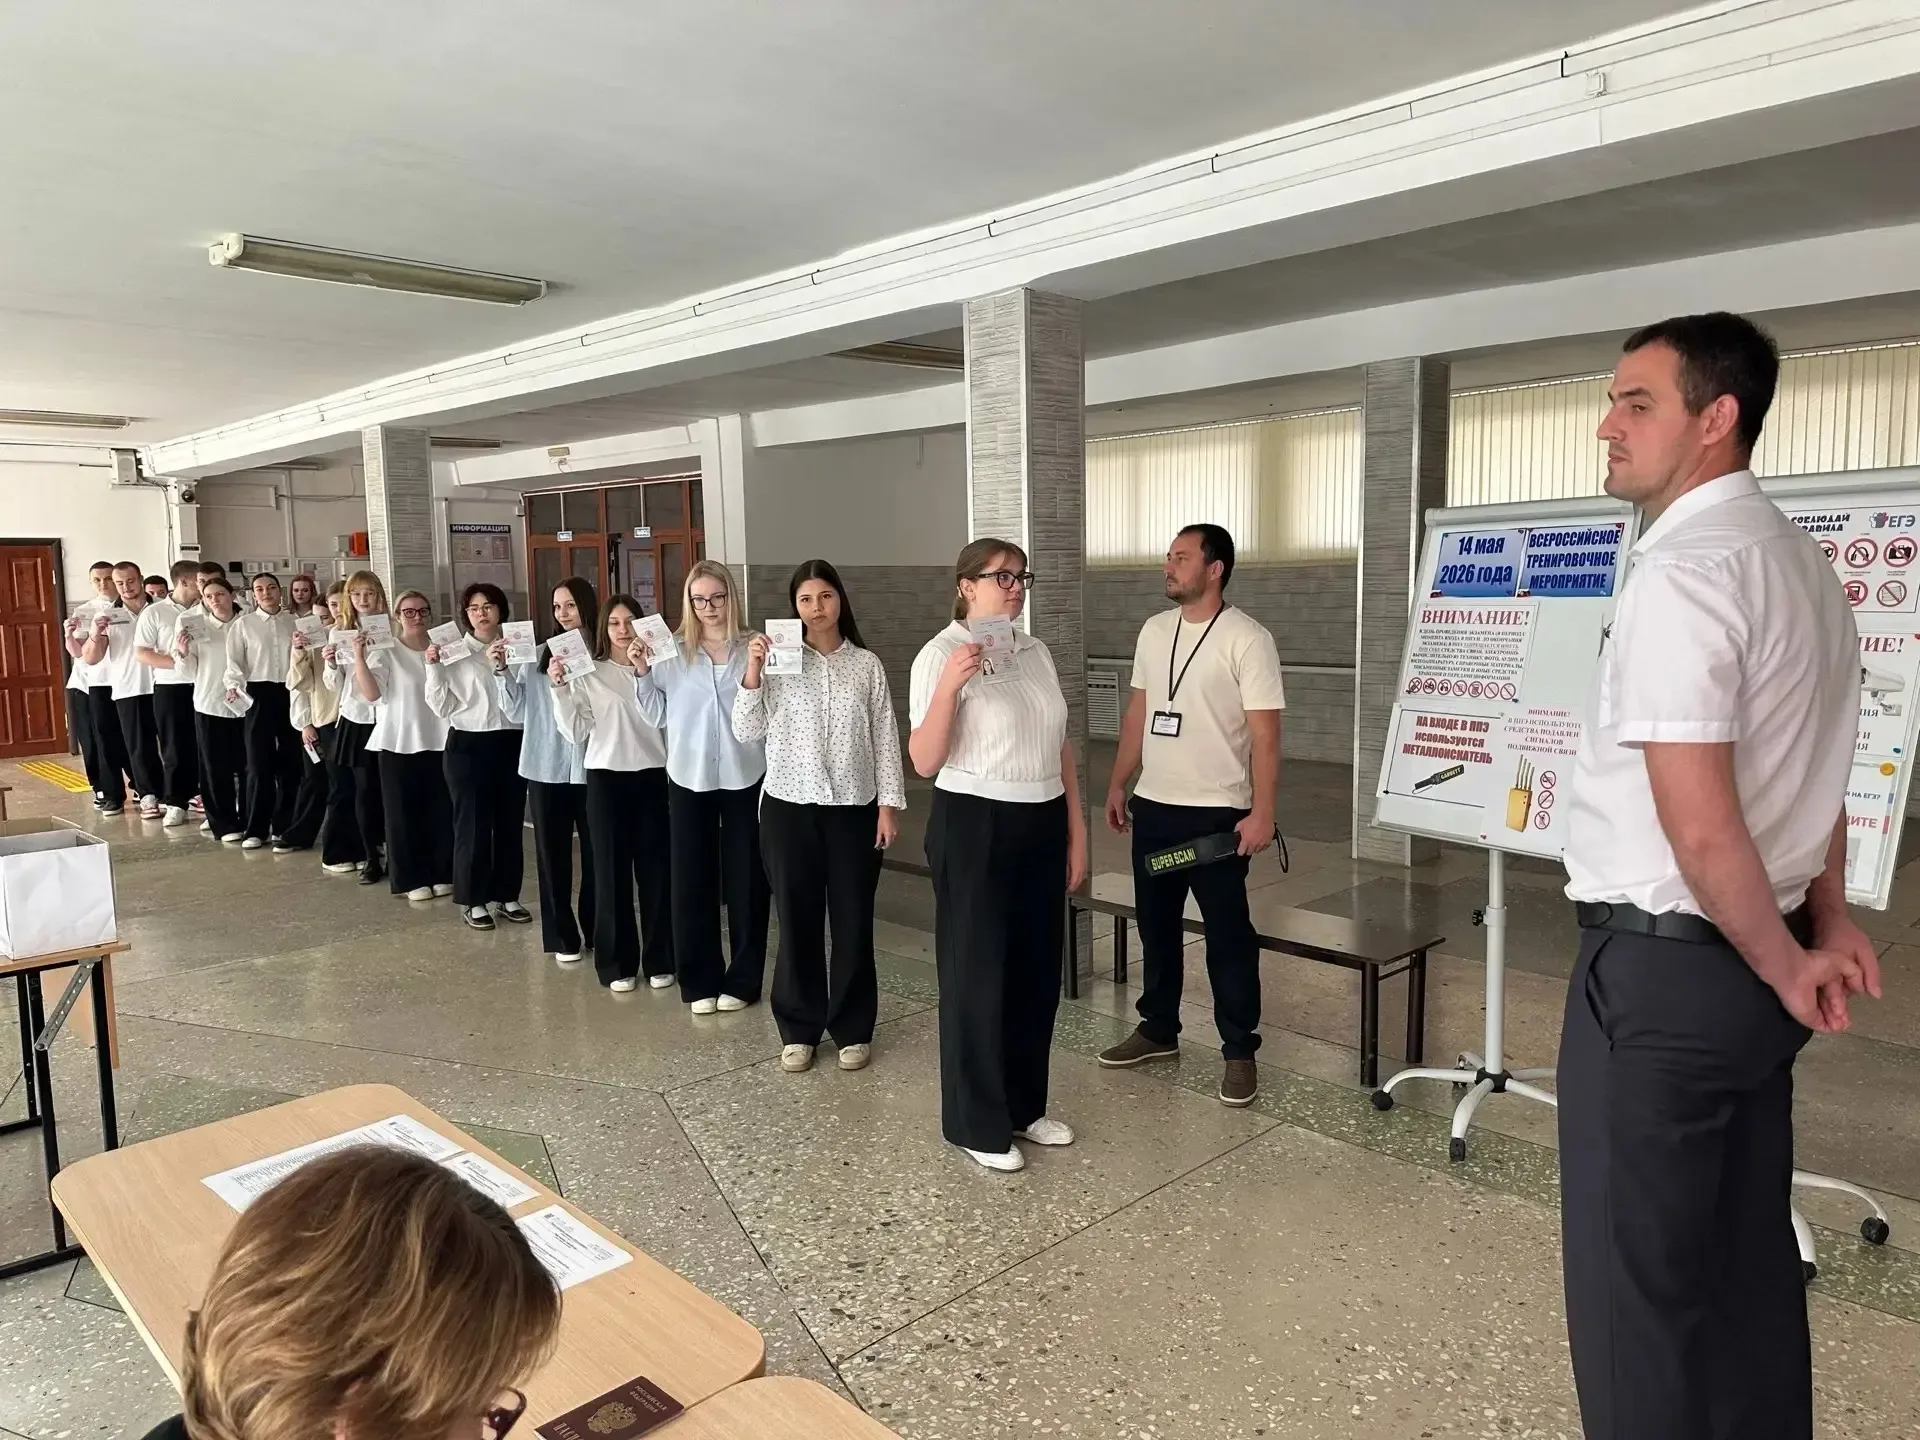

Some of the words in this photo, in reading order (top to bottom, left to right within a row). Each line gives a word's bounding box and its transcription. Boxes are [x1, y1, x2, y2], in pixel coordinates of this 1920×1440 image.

[1791, 513, 1851, 523] СОБЛЮДАЙ
[1888, 515, 1915, 528] ЕГЭ
[1459, 536, 1473, 555] 14
[1474, 537, 1505, 555] мая
[1529, 529, 1621, 548] ВСЕРОССИЙСКОЕ
[1526, 551, 1616, 569] ТРЕНИРОВОЧНОЕ
[1439, 564, 1476, 584] 2026
[1477, 565, 1513, 586] года
[1529, 573, 1607, 589] МЕРОПРИЯТИЕ
[1421, 610, 1530, 625] ВНИМАНИЕ!
[1528, 708, 1571, 718] ВНИМАНИЕ!
[1416, 716, 1428, 727] НА
[1429, 717, 1459, 731] ВХОДЕ
[1461, 719, 1468, 731] В
[1469, 720, 1490, 733] ППЭ
[1504, 725, 1539, 734] СРЕДСТВА
[1525, 736, 1564, 745] СИГНАЛОВ
[1402, 743, 1493, 764] МЕТАЛЛОИСКАТЕЛЬ
[1507, 743, 1553, 754] ПОДВИЖНОЙ
[1554, 748, 1577, 756] СВЯЗИ
[1151, 853, 1174, 870] SUPER
